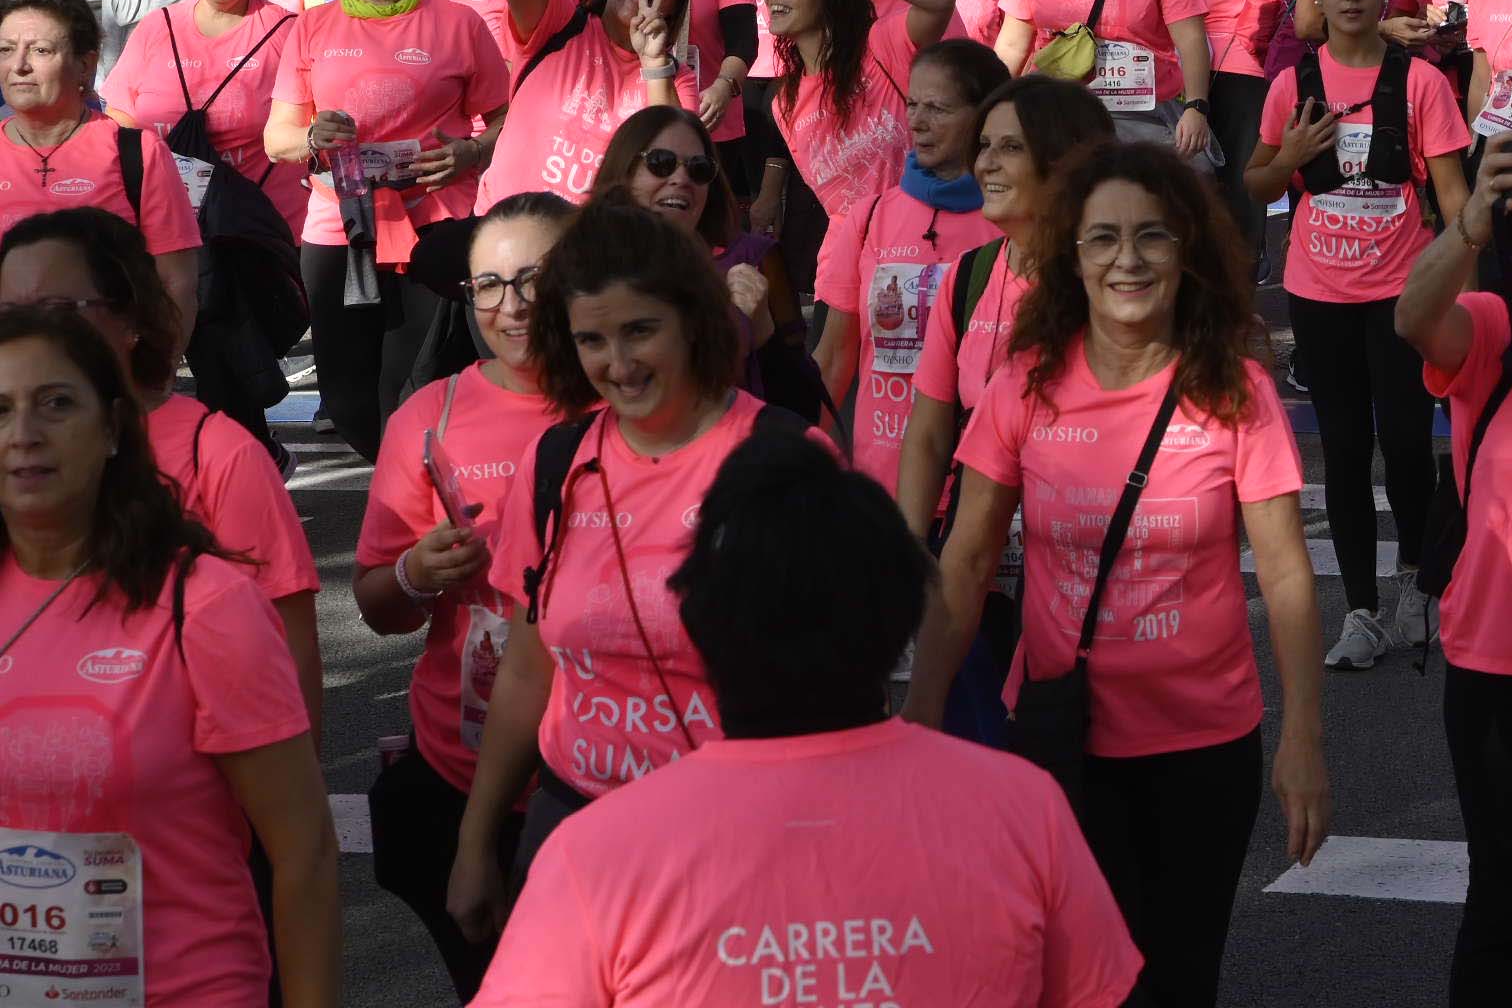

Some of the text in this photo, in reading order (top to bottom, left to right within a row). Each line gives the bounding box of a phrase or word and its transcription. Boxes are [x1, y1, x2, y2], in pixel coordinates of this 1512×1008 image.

[324, 47, 363, 58] OYSHO
[168, 58, 202, 69] OSHO
[1098, 66, 1126, 77] 016
[552, 136, 576, 157] TU
[1309, 231, 1382, 259] SUMA
[1032, 426, 1098, 444] OYSHO
[567, 511, 633, 530] OYSHO
[1134, 609, 1181, 641] 2019
[550, 645, 596, 681] TU
[83, 855, 125, 866] SUMA
[1, 902, 66, 931] 016
[7, 936, 58, 954] 17468
[717, 916, 934, 966] CARRERA
[12, 960, 29, 972] DE
[31, 961, 46, 973] LA
[48, 962, 88, 974] MUJER
[760, 960, 894, 1006] DE LA
